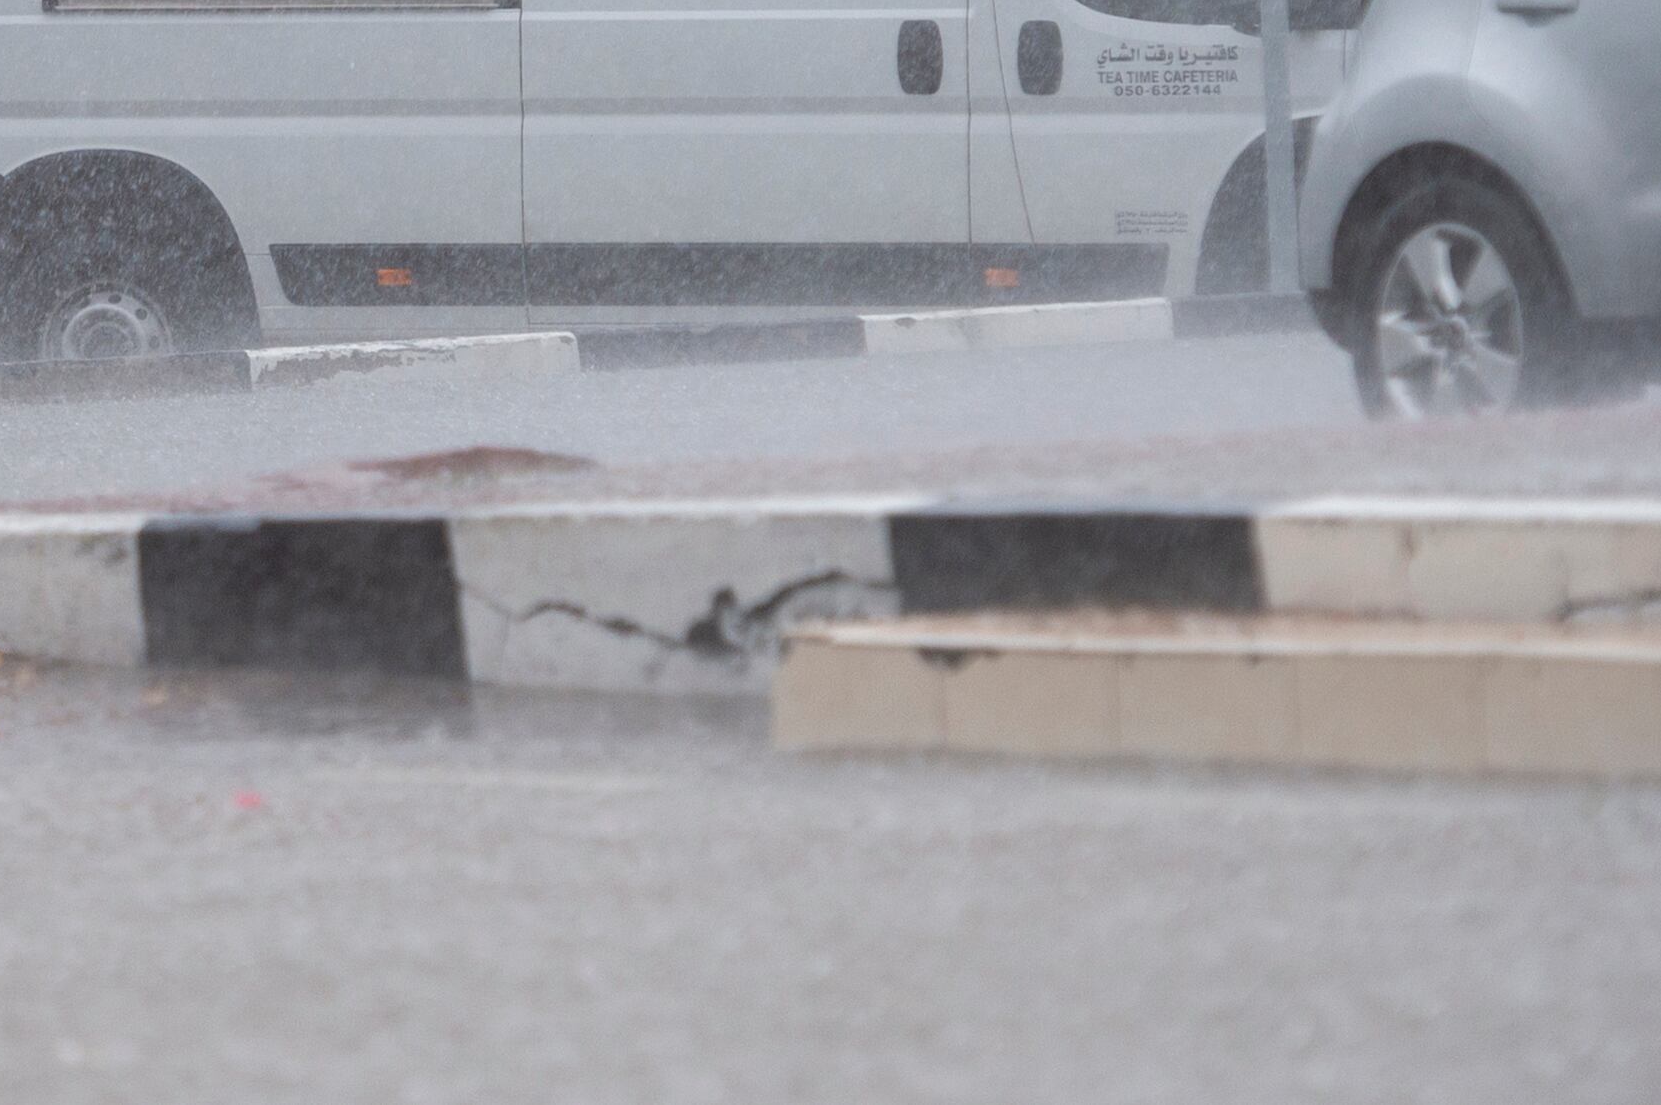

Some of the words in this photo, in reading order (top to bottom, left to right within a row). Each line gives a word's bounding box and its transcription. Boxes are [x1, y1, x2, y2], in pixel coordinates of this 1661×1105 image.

[1096, 42, 1141, 69] الشاي
[1144, 44, 1174, 66] وقت
[1178, 43, 1240, 66] كافتيريا
[1097, 70, 1124, 84] TEA
[1126, 70, 1160, 84] TIME
[1163, 69, 1239, 83] CAFETERIA
[1113, 84, 1222, 97] 050-6322144
